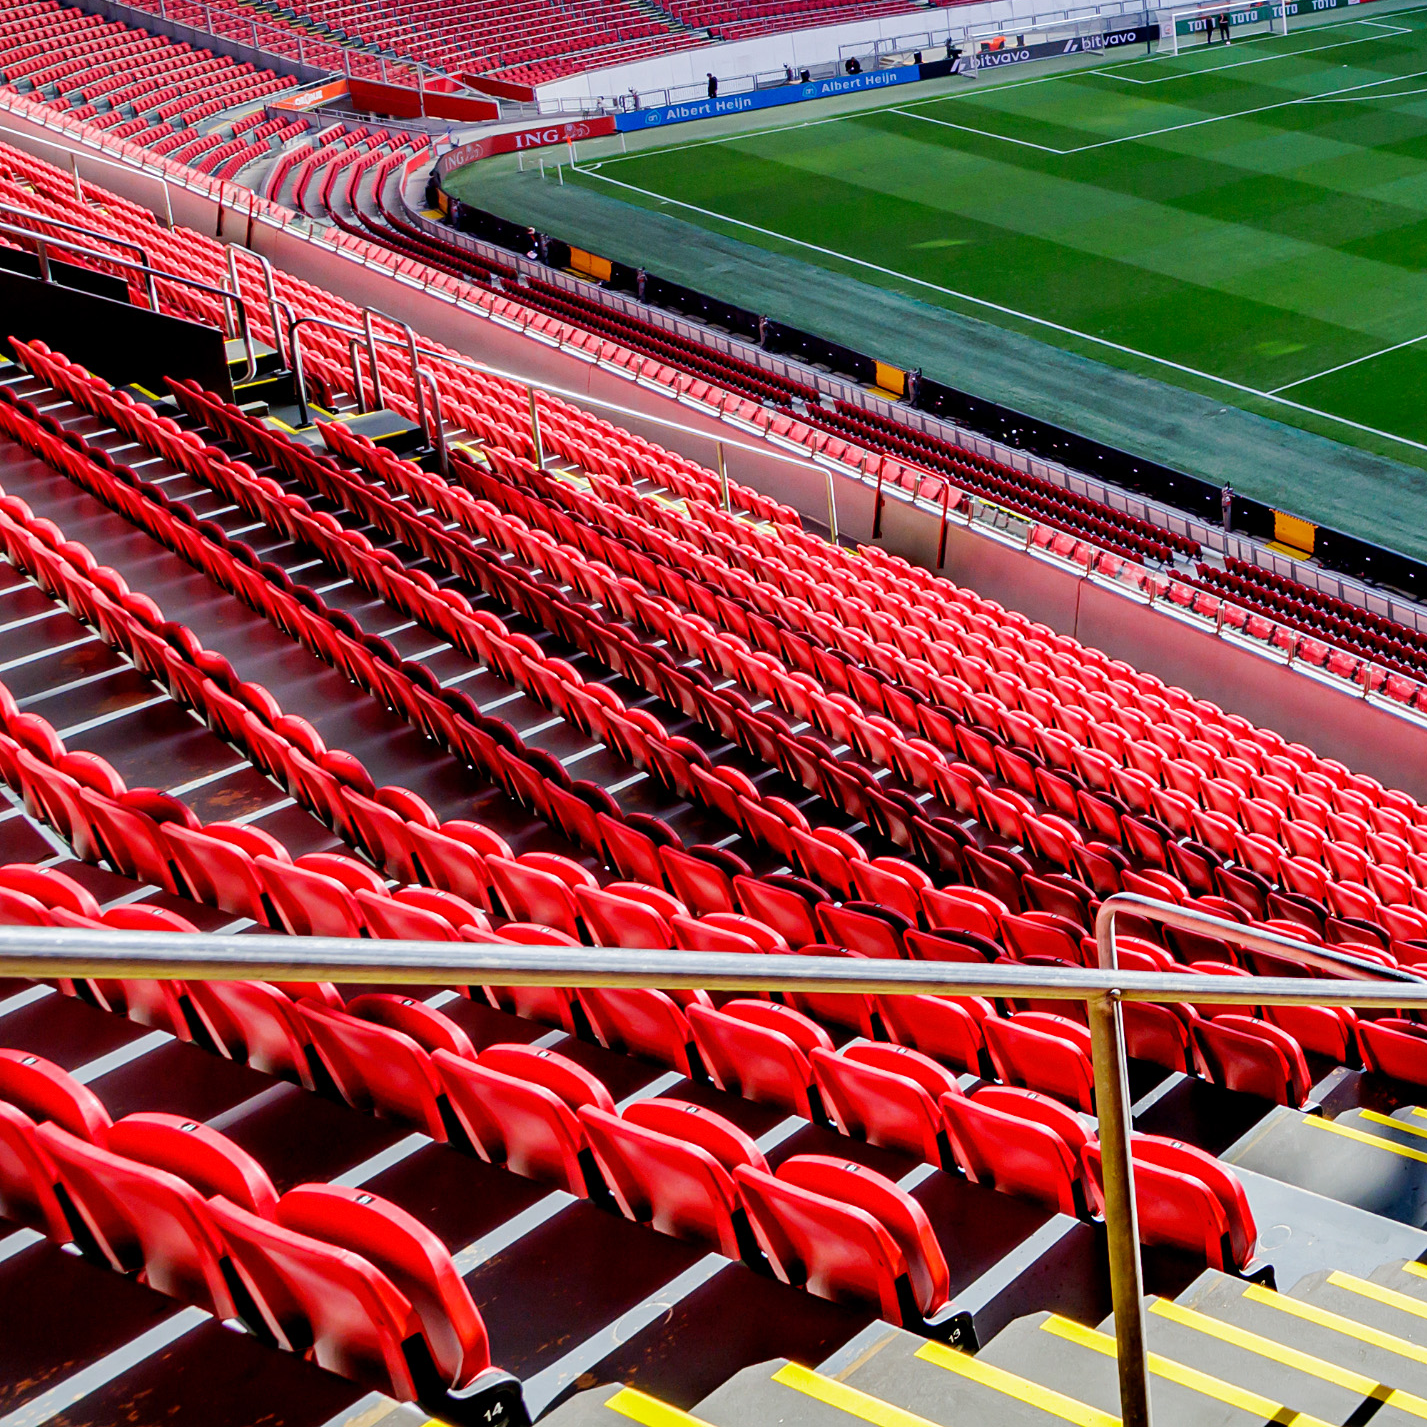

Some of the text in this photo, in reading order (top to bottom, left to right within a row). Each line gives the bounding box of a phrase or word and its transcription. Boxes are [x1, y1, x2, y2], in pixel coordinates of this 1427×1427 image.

[1231, 11, 1258, 24] TOTO
[1081, 32, 1137, 50] bitvavo
[970, 49, 1030, 68] bitvavo
[821, 76, 862, 93] Albert
[865, 72, 897, 86] Heijn
[666, 104, 710, 121] Albert
[715, 98, 752, 113] Heijn
[515, 129, 559, 148] ING
[445, 155, 464, 171] ING
